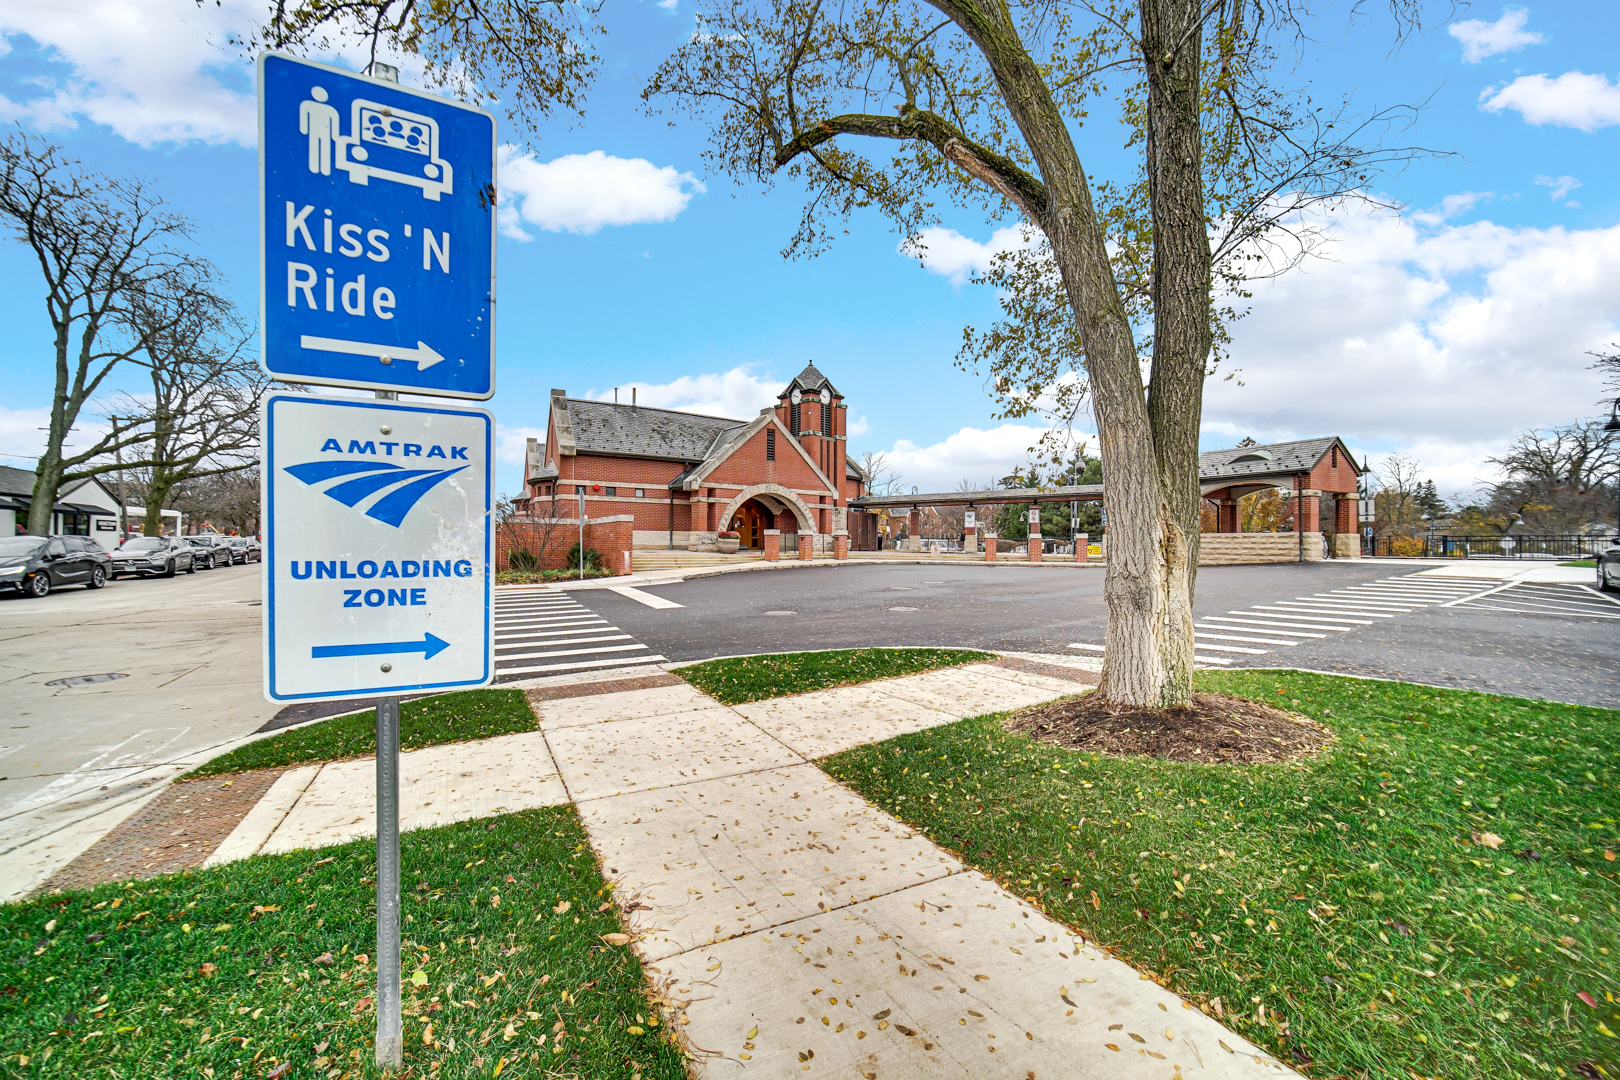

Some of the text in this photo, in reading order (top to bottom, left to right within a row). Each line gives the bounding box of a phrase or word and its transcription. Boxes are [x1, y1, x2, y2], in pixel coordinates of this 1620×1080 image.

[286, 201, 450, 274] Kiss 'N
[287, 261, 396, 320] Ride
[320, 438, 470, 460] AMTRAK
[291, 560, 472, 580] UNLOADING
[343, 588, 427, 608] ZONE
